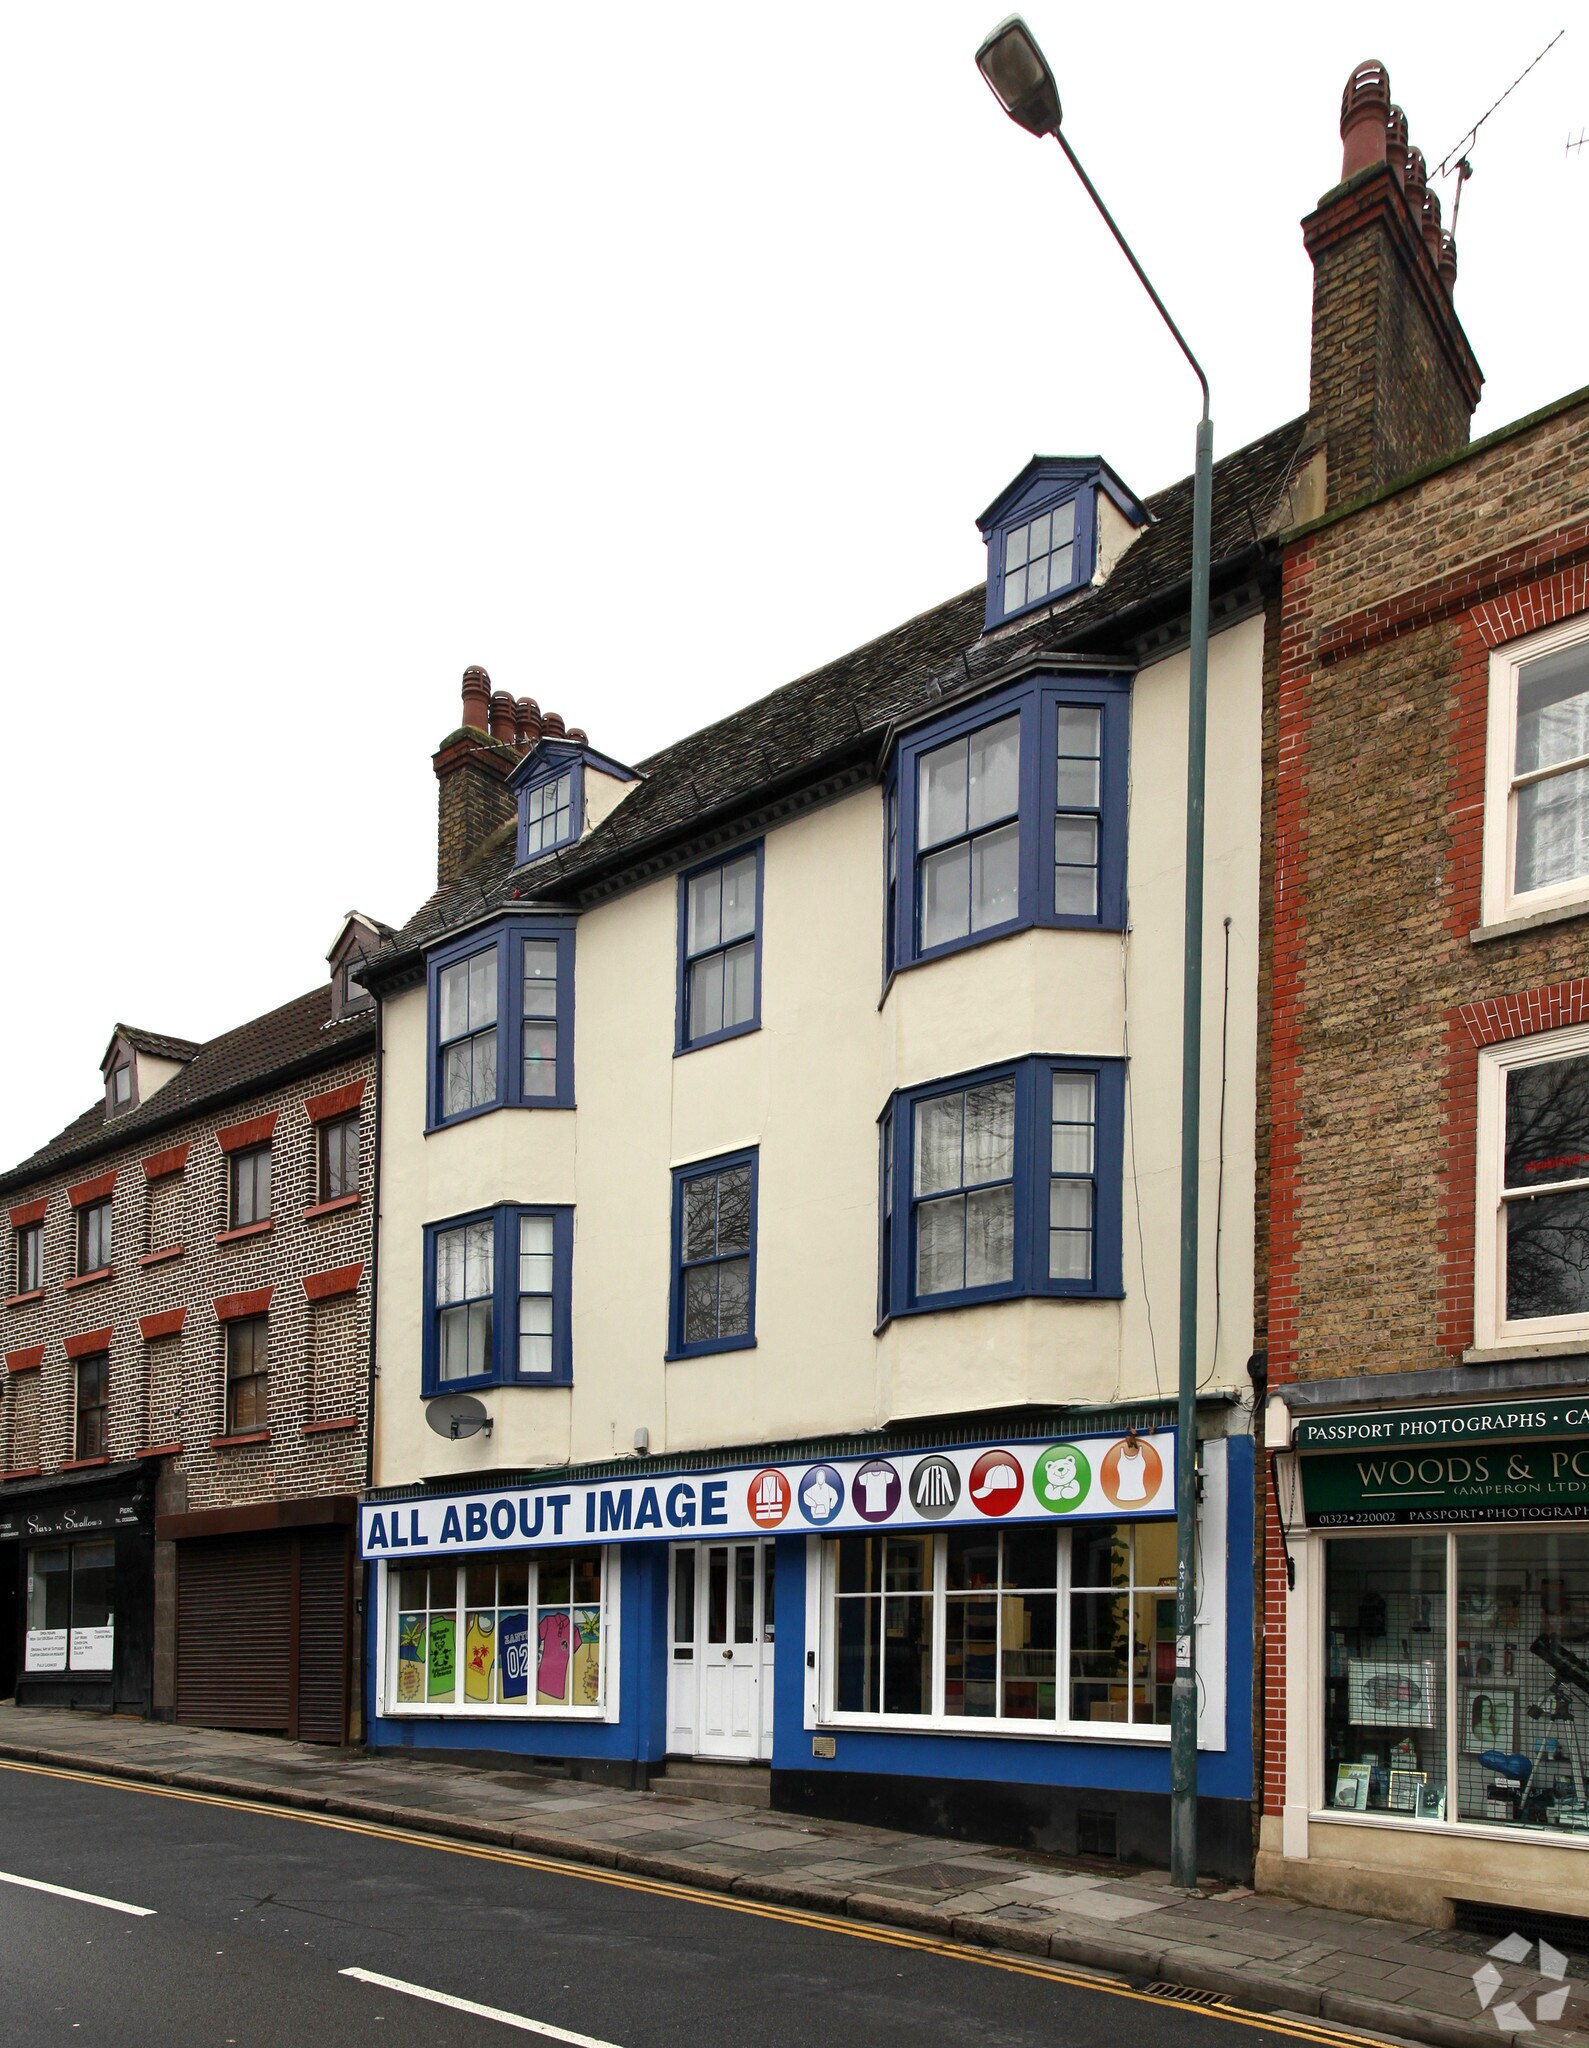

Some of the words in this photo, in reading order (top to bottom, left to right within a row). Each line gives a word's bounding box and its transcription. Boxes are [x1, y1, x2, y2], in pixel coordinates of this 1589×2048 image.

[1308, 1423, 1394, 1440] PASSPORT
[1400, 1412, 1547, 1436] PHOTOGRAPHS
[1357, 1456, 1490, 1487] WOODS
[1507, 1454, 1535, 1480] &
[1453, 1483, 1541, 1496] (AMPERON
[1548, 1481, 1587, 1493] LTD)
[27, 1514, 52, 1535] Stars
[63, 1509, 103, 1529] Swallows
[367, 1509, 429, 1550] ALL
[440, 1494, 571, 1544] ABOUT
[586, 1480, 728, 1533] IMAGE
[506, 1642, 529, 1679] 02
